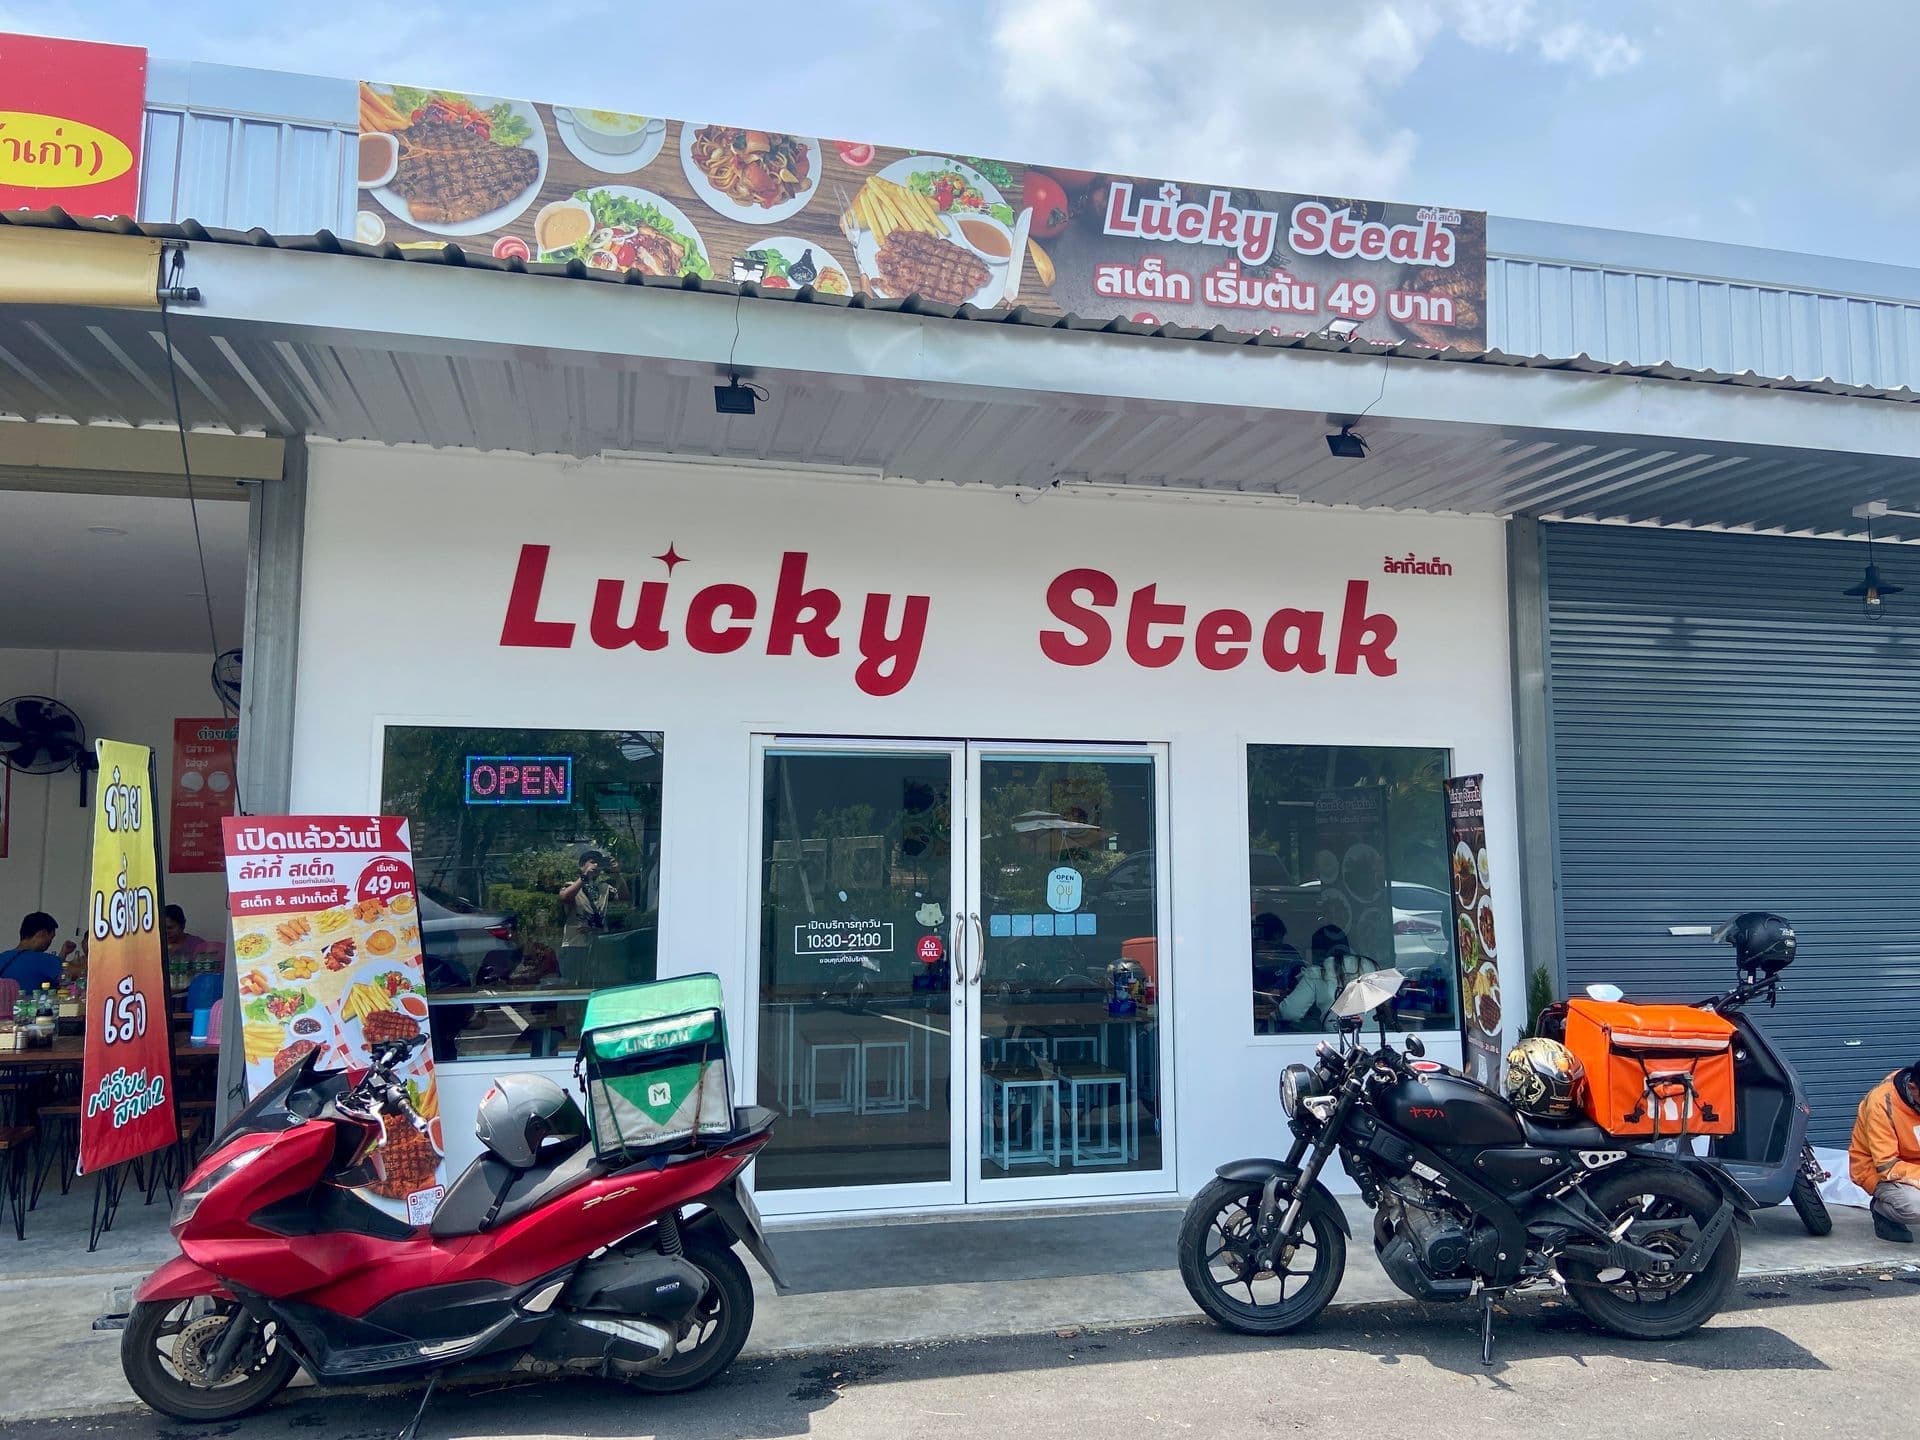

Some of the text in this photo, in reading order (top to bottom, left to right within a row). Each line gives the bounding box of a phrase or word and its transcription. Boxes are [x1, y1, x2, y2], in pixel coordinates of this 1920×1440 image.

[1104, 182, 1455, 268] Lucky Steak
[1097, 257, 1453, 322] สเต็ก เริ่มต้น 49 บาท
[500, 543, 1398, 697] Lucky Steak
[473, 765, 565, 795] OPEN
[236, 818, 382, 851] เปิดแล้ววันนี้
[239, 855, 334, 880] ลัคกี้ สเต็ก
[376, 863, 399, 873] เริ่มต้น
[240, 888, 339, 909] สเต็ก & สปาเก็ตตี้
[364, 875, 411, 895] 49 บาท
[807, 919, 881, 932] เปิดบริการทุกวัน
